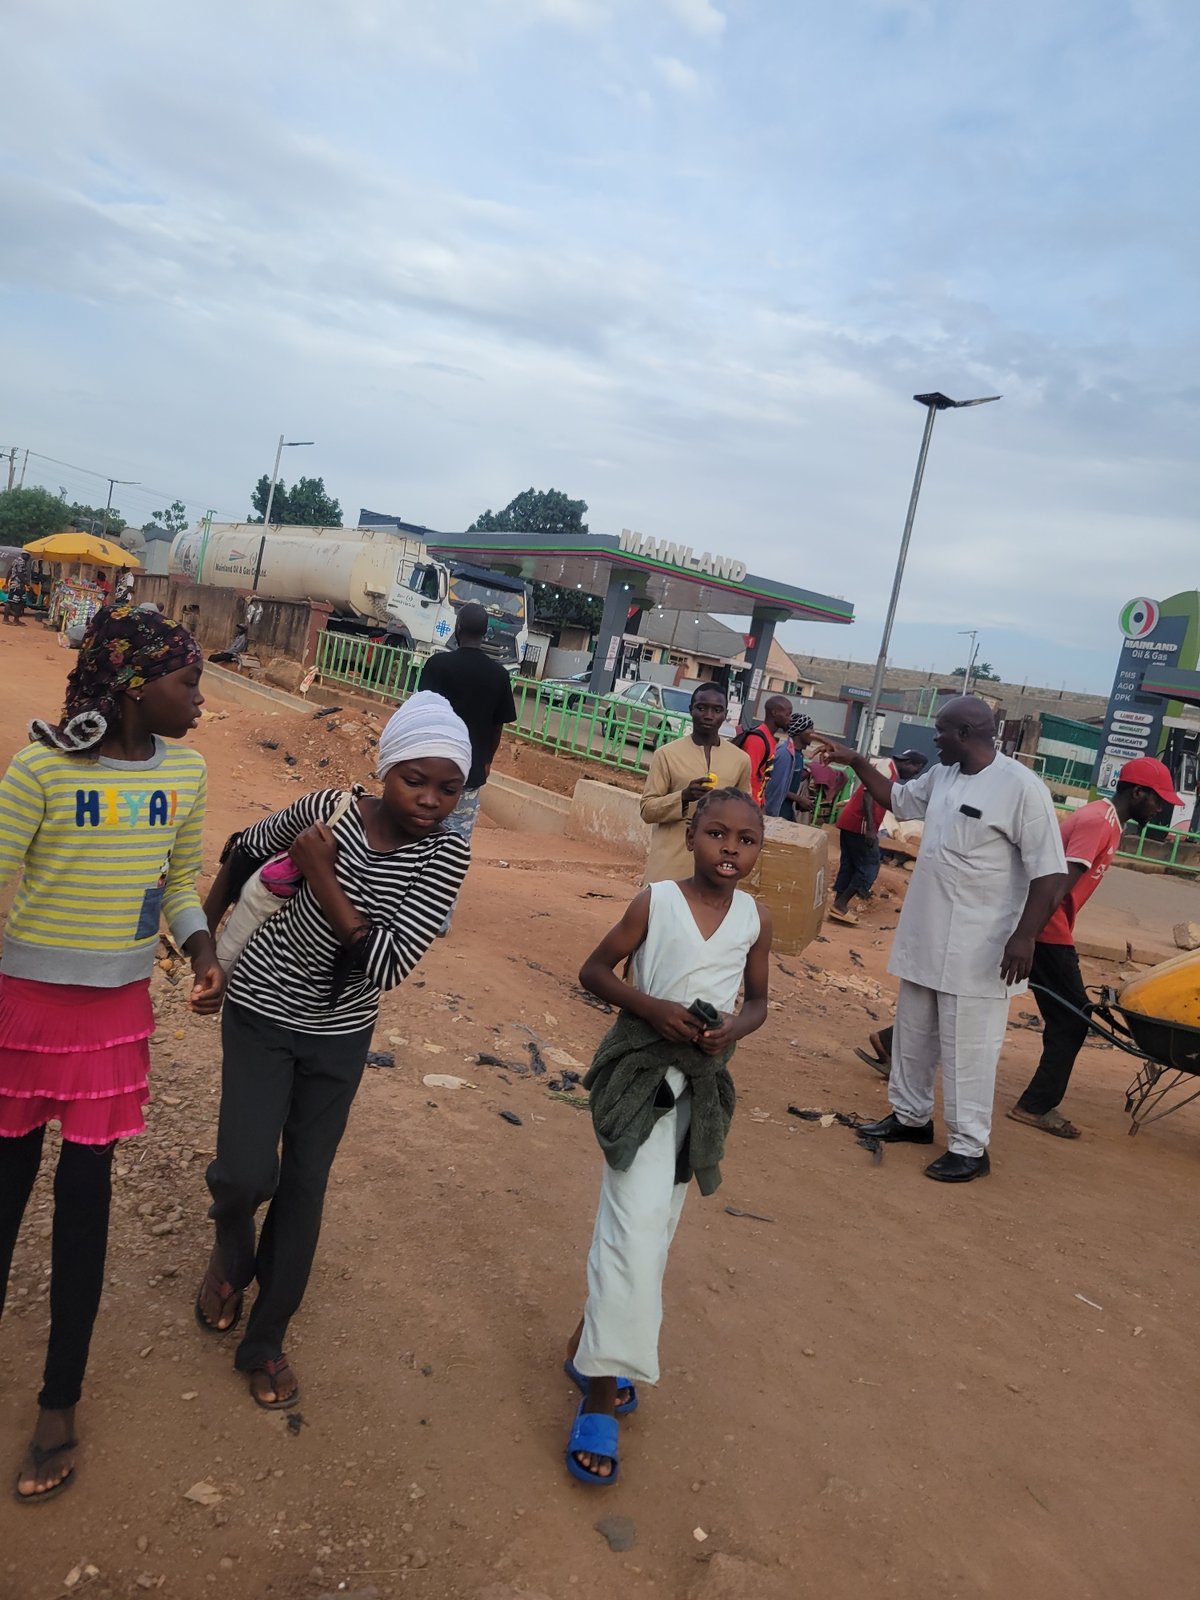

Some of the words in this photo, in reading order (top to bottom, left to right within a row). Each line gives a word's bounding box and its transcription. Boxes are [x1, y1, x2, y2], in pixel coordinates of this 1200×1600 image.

[619, 528, 747, 582] MAINLAND
[1124, 640, 1178, 651] MAINLAND
[1132, 650, 1143, 658] Oil
[1144, 650, 1150, 659] &
[1151, 651, 1168, 661] Gas
[1120, 671, 1136, 679] PMS
[1117, 683, 1135, 691] AGO
[1114, 693, 1131, 702] DPK
[1111, 736, 1143, 746] LUBRICANTS
[76, 788, 177, 828] HIYA!
